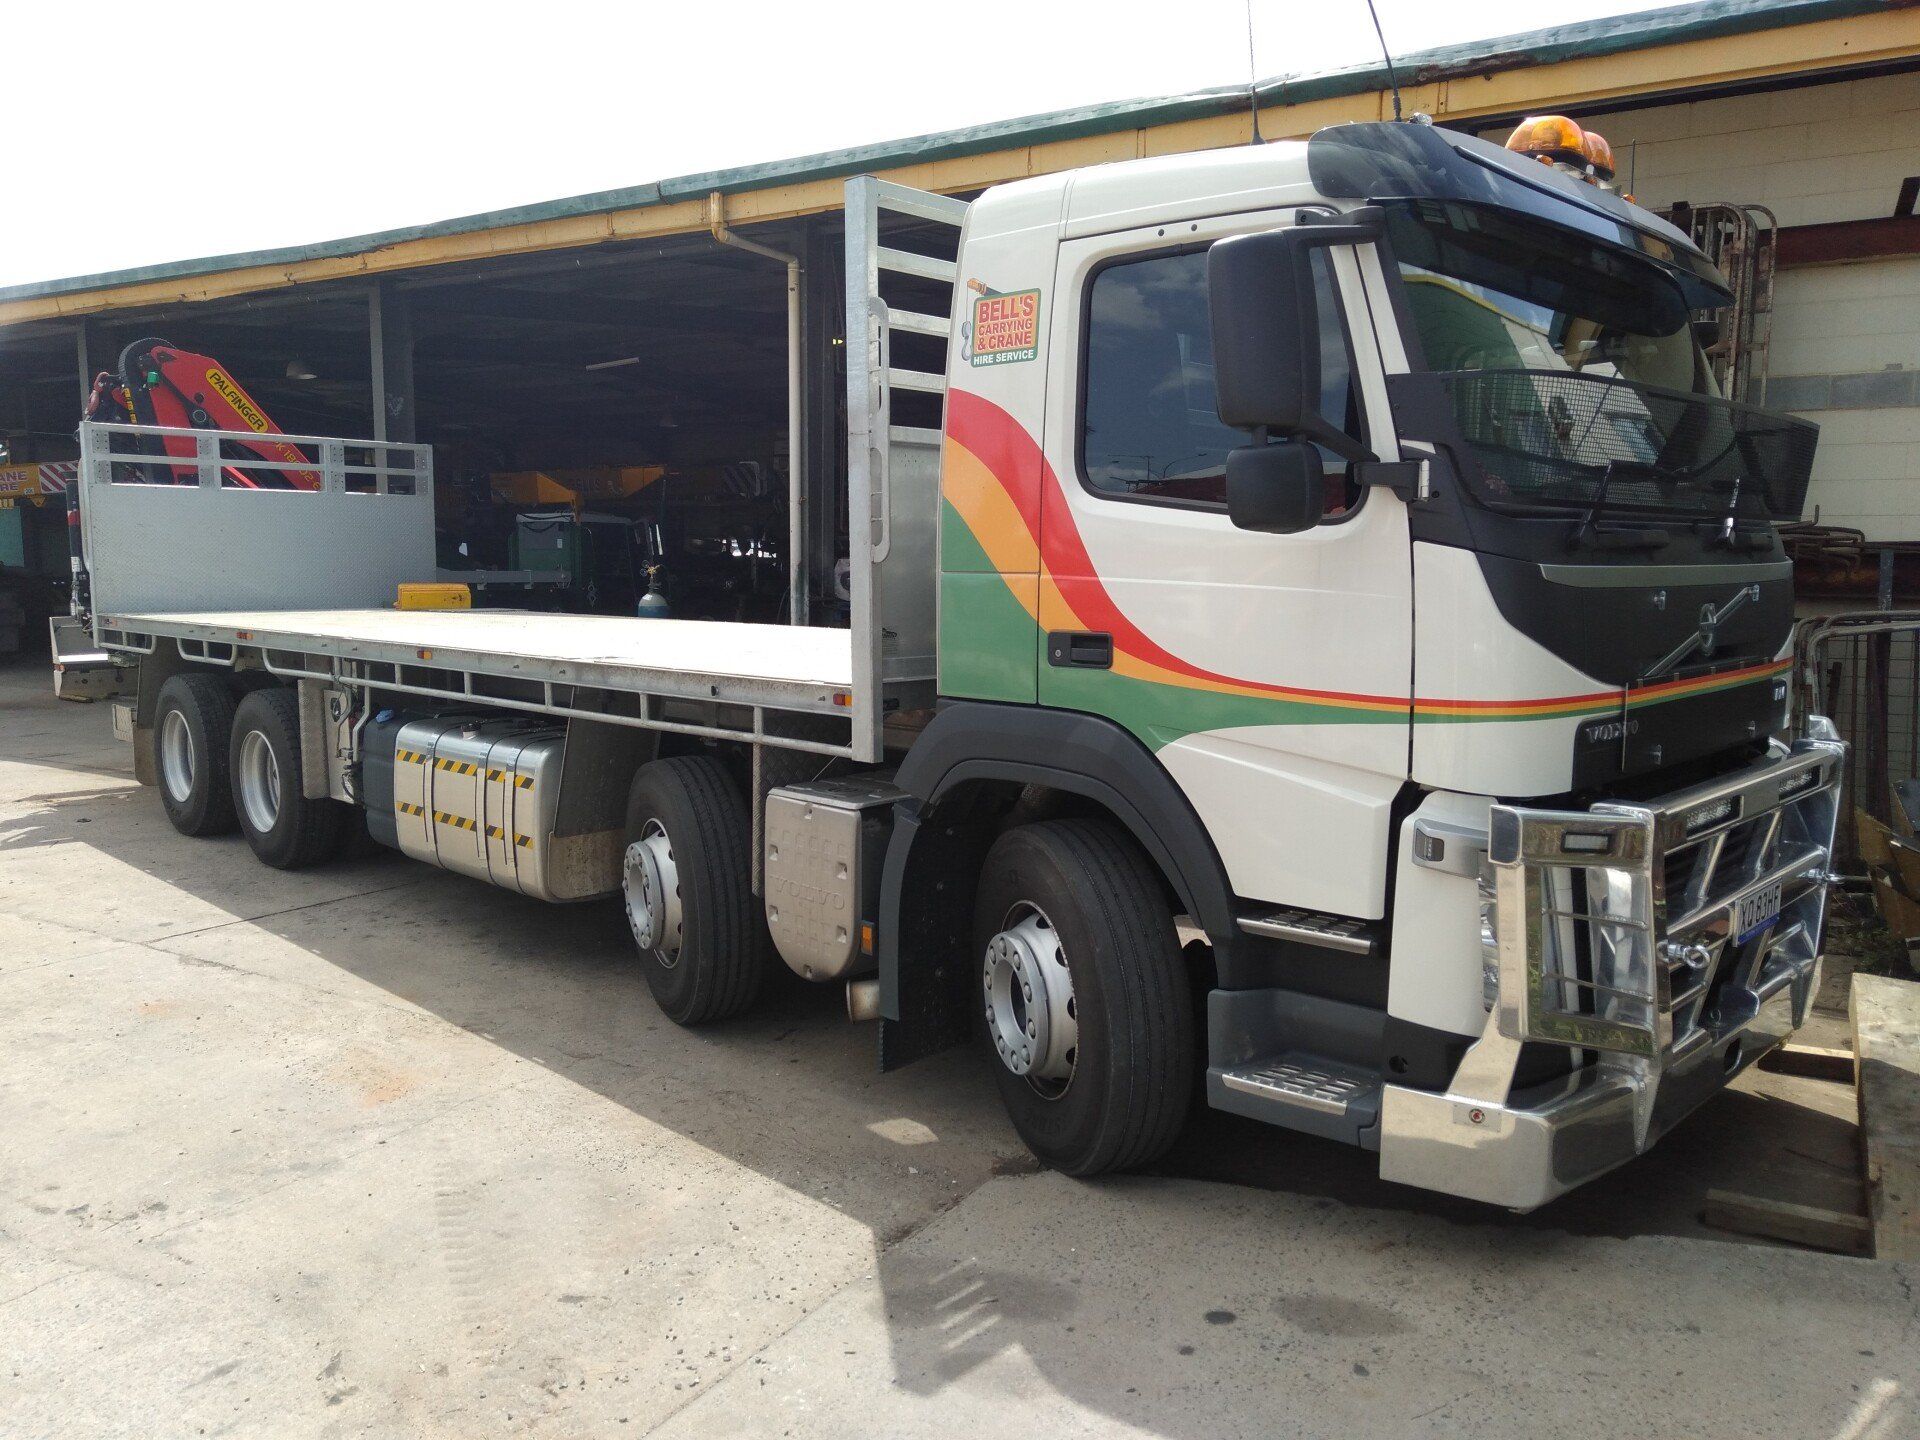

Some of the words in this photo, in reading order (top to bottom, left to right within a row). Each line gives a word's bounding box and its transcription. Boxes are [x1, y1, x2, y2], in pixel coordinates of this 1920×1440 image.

[979, 294, 1034, 323] BELL'S
[978, 318, 1033, 336] CARRYING
[977, 337, 986, 351] &
[988, 331, 1032, 350] CRANE
[973, 354, 993, 365] HIRE
[996, 349, 1034, 363] SERVICE
[209, 371, 265, 430] PALFINGER
